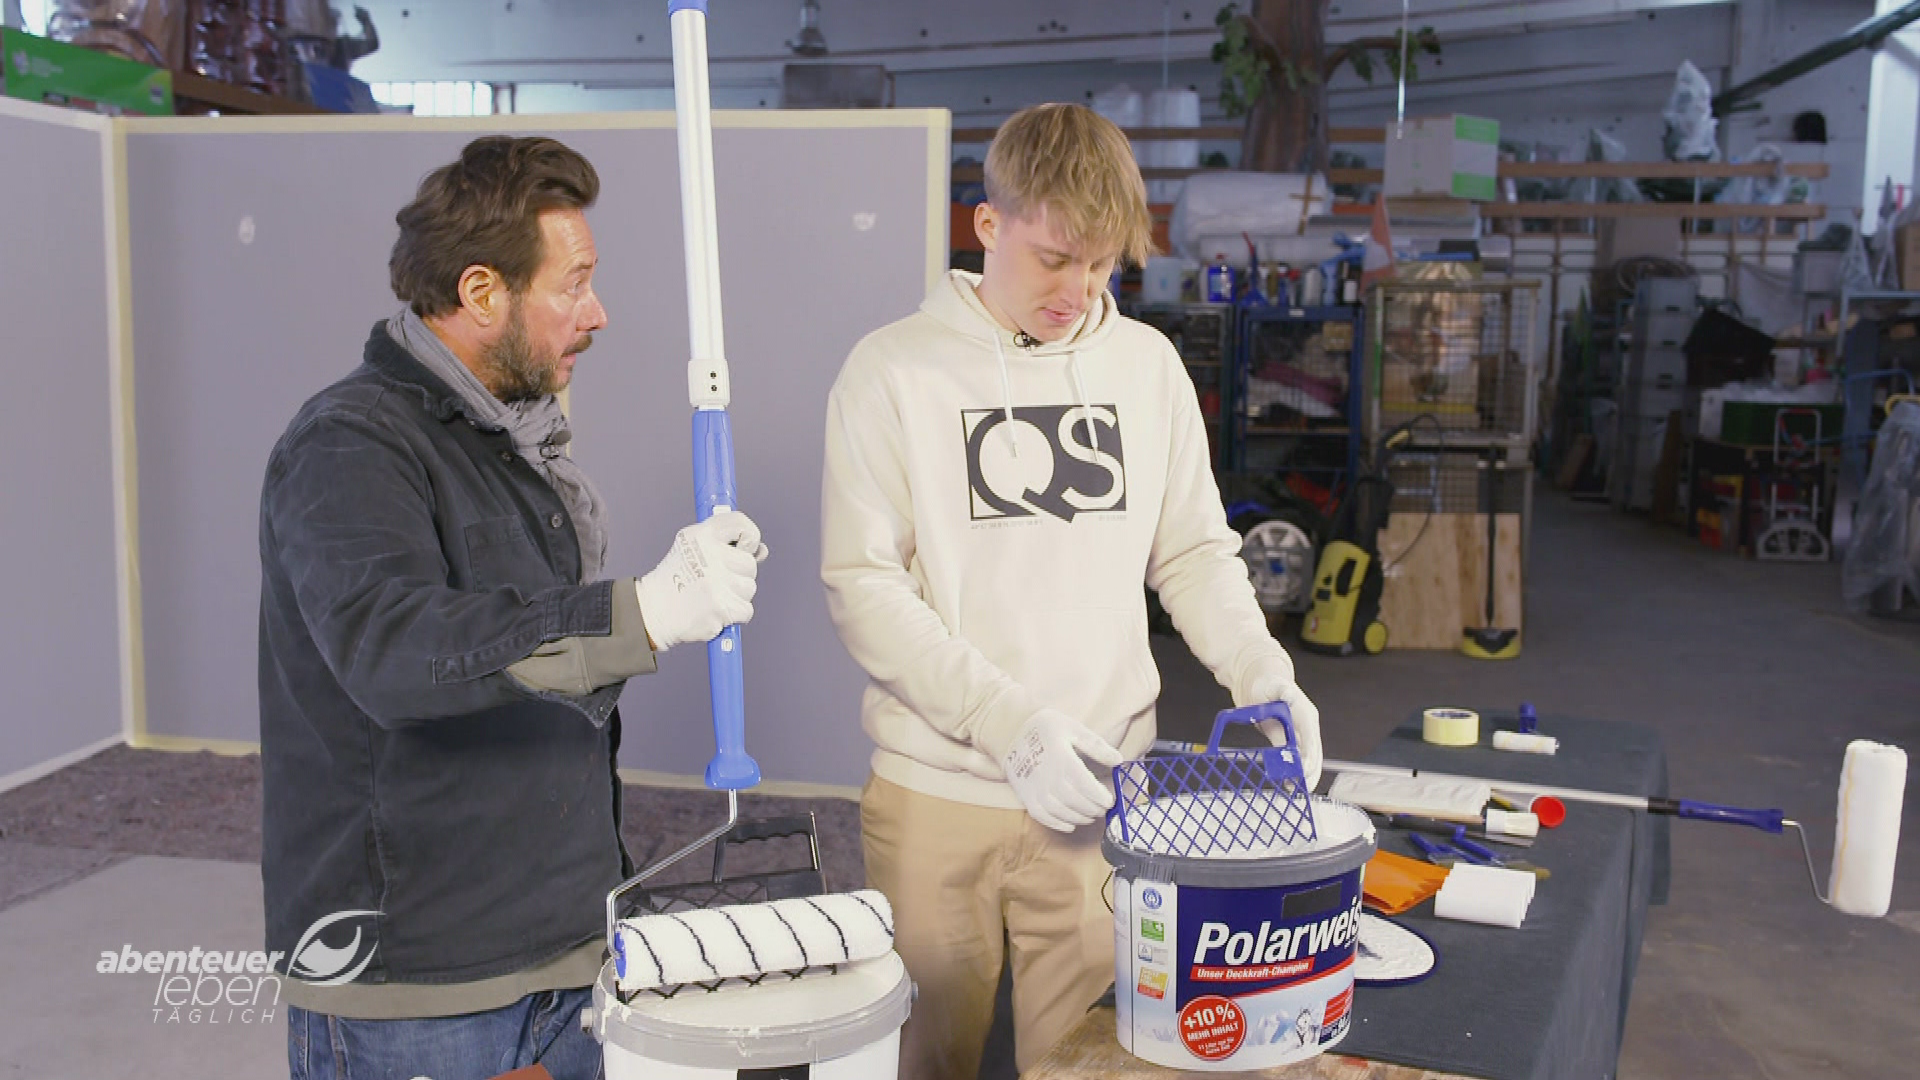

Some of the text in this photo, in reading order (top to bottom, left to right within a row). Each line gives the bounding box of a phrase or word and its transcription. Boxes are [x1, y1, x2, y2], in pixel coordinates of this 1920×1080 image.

[978, 406, 1125, 523] QS
[1196, 962, 1309, 978] Unser Deckkraft-Champion
[1211, 1021, 1238, 1037] INHALT
